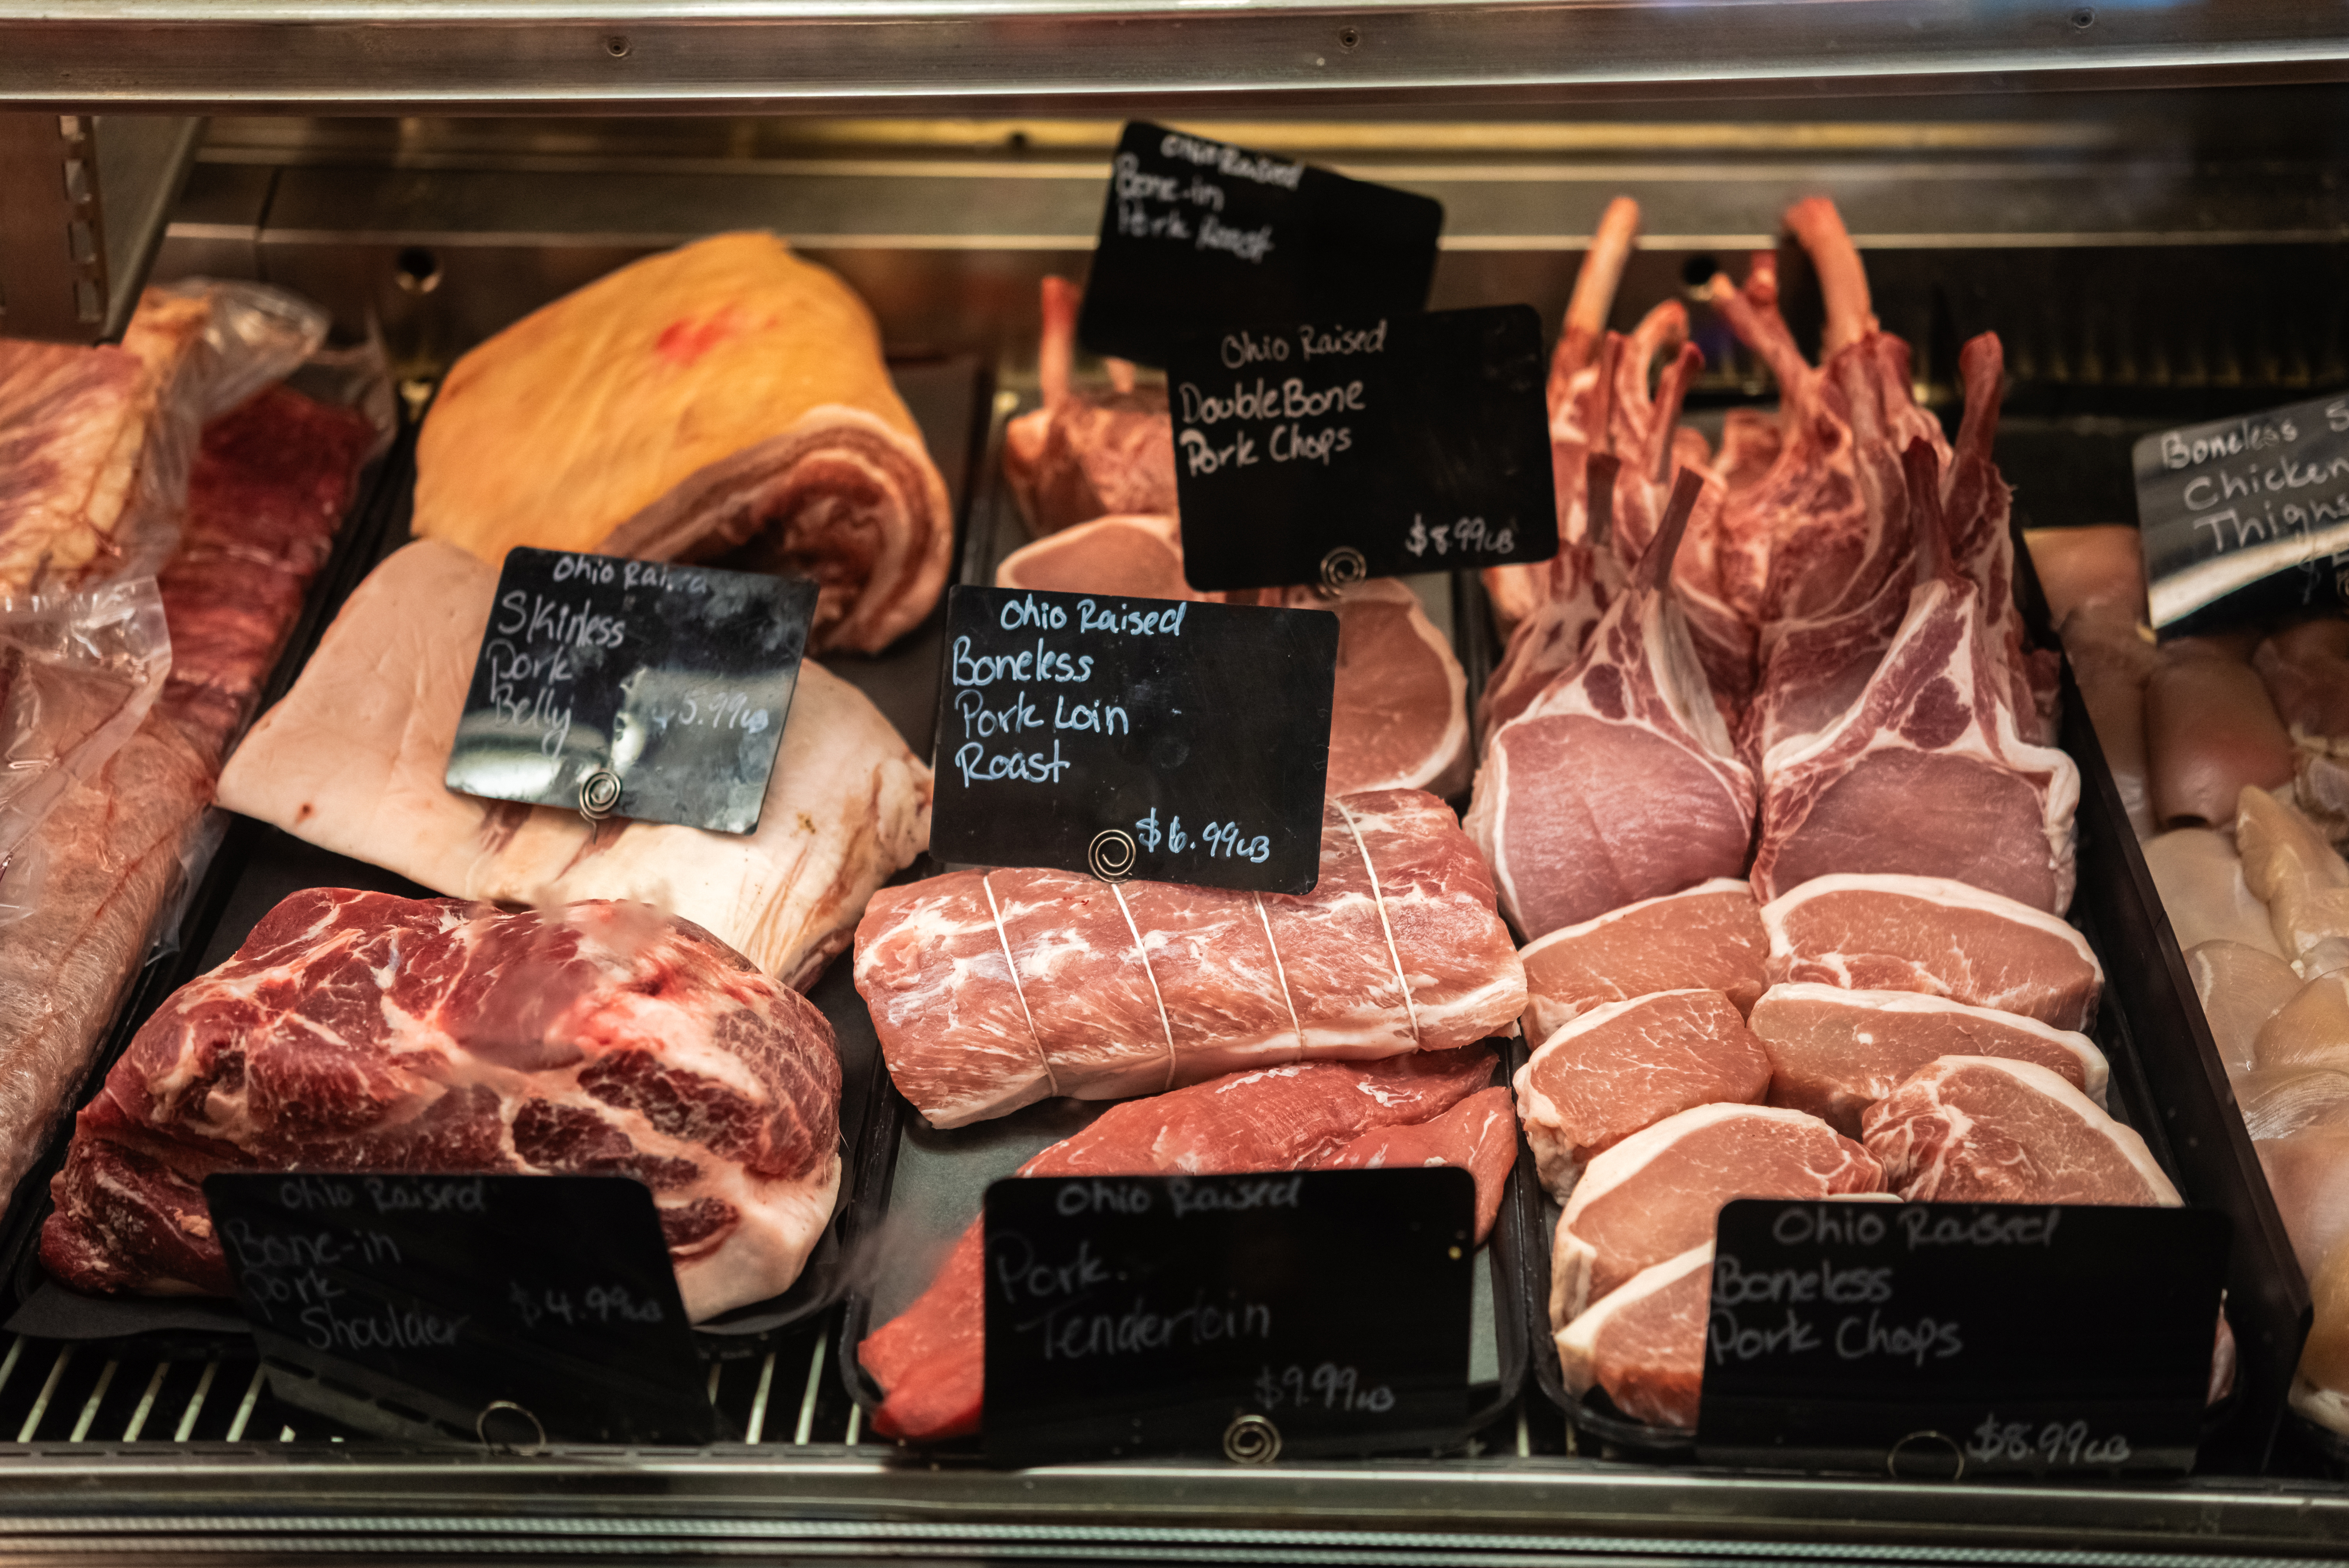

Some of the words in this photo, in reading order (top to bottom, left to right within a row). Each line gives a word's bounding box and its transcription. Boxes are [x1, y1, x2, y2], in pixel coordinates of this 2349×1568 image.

[1221, 331, 1289, 368] Ohio
[1299, 319, 1388, 360] Raised
[1179, 428, 1260, 476] Pork
[1269, 423, 1353, 465] Chops
[2161, 419, 2298, 469] Boneless
[2184, 456, 2349, 510] Chicken
[553, 554, 615, 584] Ohio
[497, 590, 625, 648] Skinless
[1000, 593, 1067, 630] Ohio
[1077, 599, 1187, 636] Raised
[486, 639, 573, 703] Pork
[953, 636, 1095, 686] Boneless
[496, 682, 574, 759] Belly
[954, 690, 1045, 738] Pork
[1055, 695, 1129, 736] Loin
[955, 739, 1071, 789] Roast
[280, 1175, 354, 1210] Ohio
[371, 1177, 487, 1214] Raised
[1056, 1182, 1153, 1216] Ohio
[1170, 1176, 1303, 1218] Raised
[223, 1217, 403, 1269] Bone-in
[1773, 1206, 1887, 1245] Ohio
[1898, 1208, 2062, 1250] Raised
[1714, 1254, 1895, 1306] Boneless
[301, 1301, 470, 1349] Shoulder
[1015, 1288, 1270, 1360] Tenderloin
[1708, 1310, 1822, 1365] Pork
[1834, 1310, 1965, 1367] Chops
